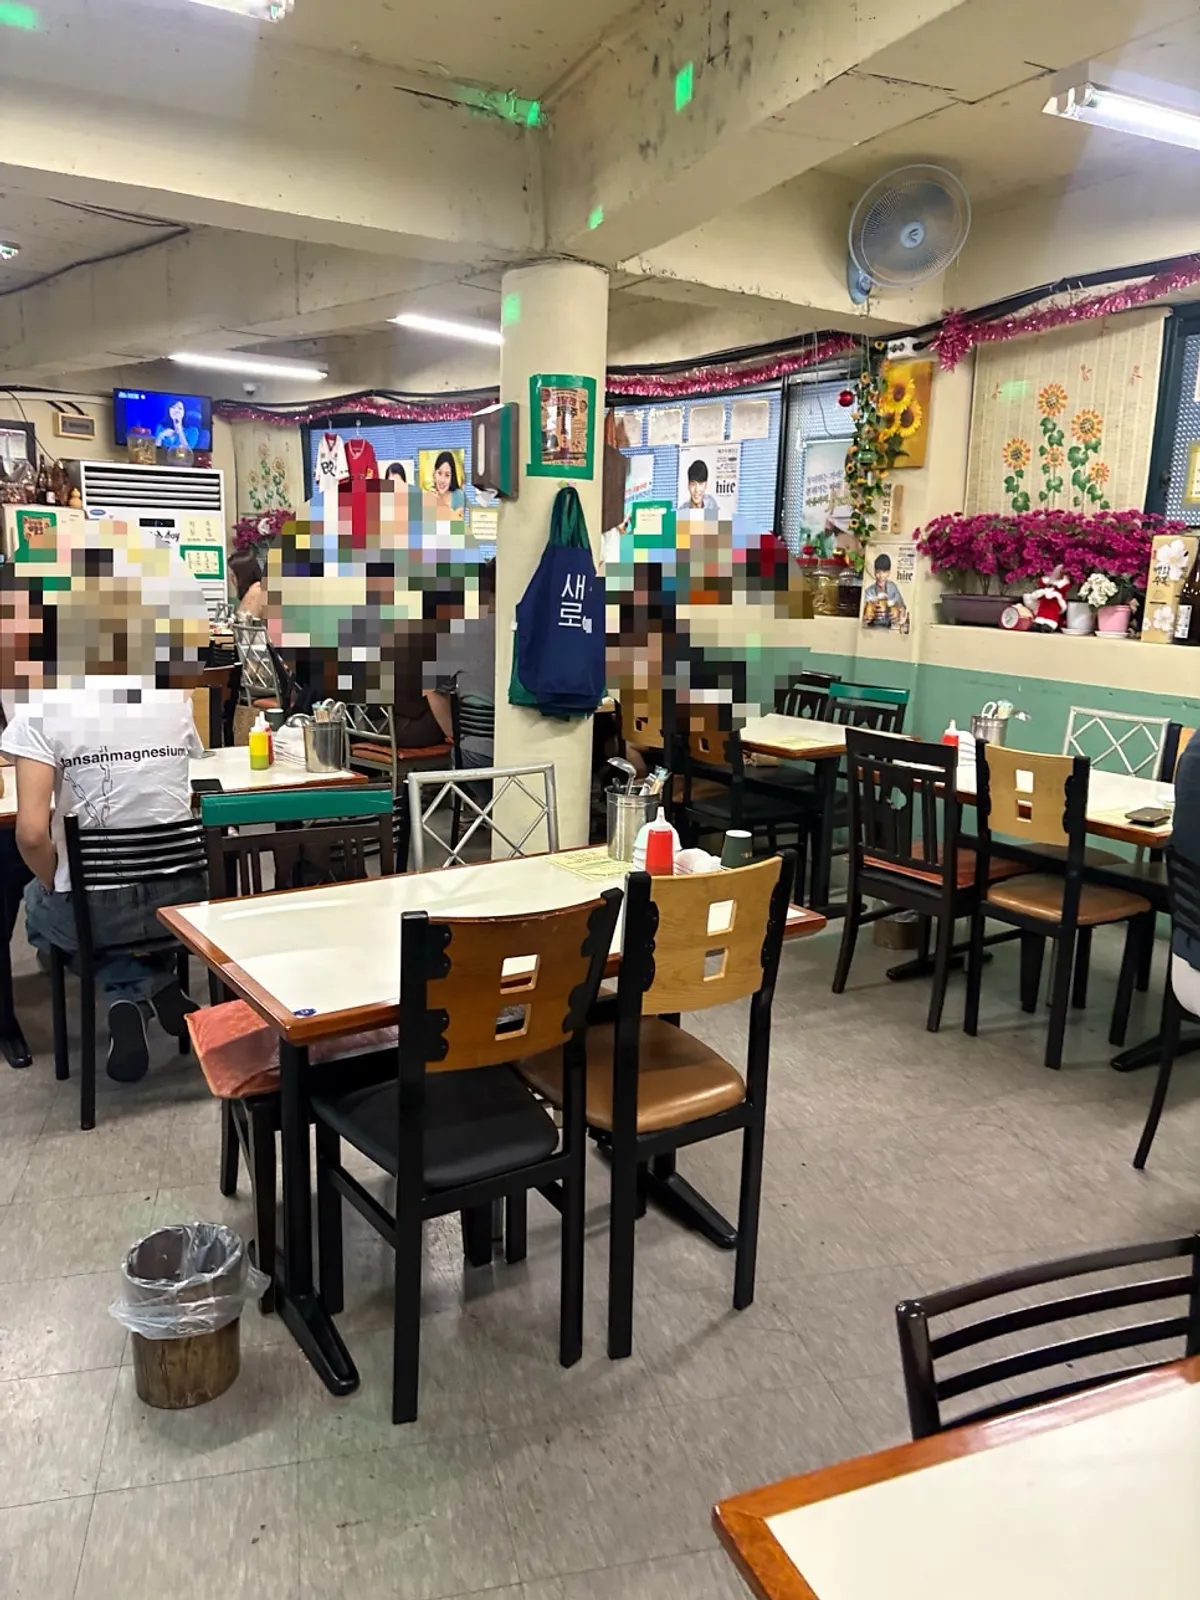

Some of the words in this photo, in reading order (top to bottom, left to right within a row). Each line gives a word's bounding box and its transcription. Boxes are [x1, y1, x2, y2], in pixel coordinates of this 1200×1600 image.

[716, 480, 736, 493] hite
[897, 571, 913, 581] hite
[558, 574, 586, 627] 새로
